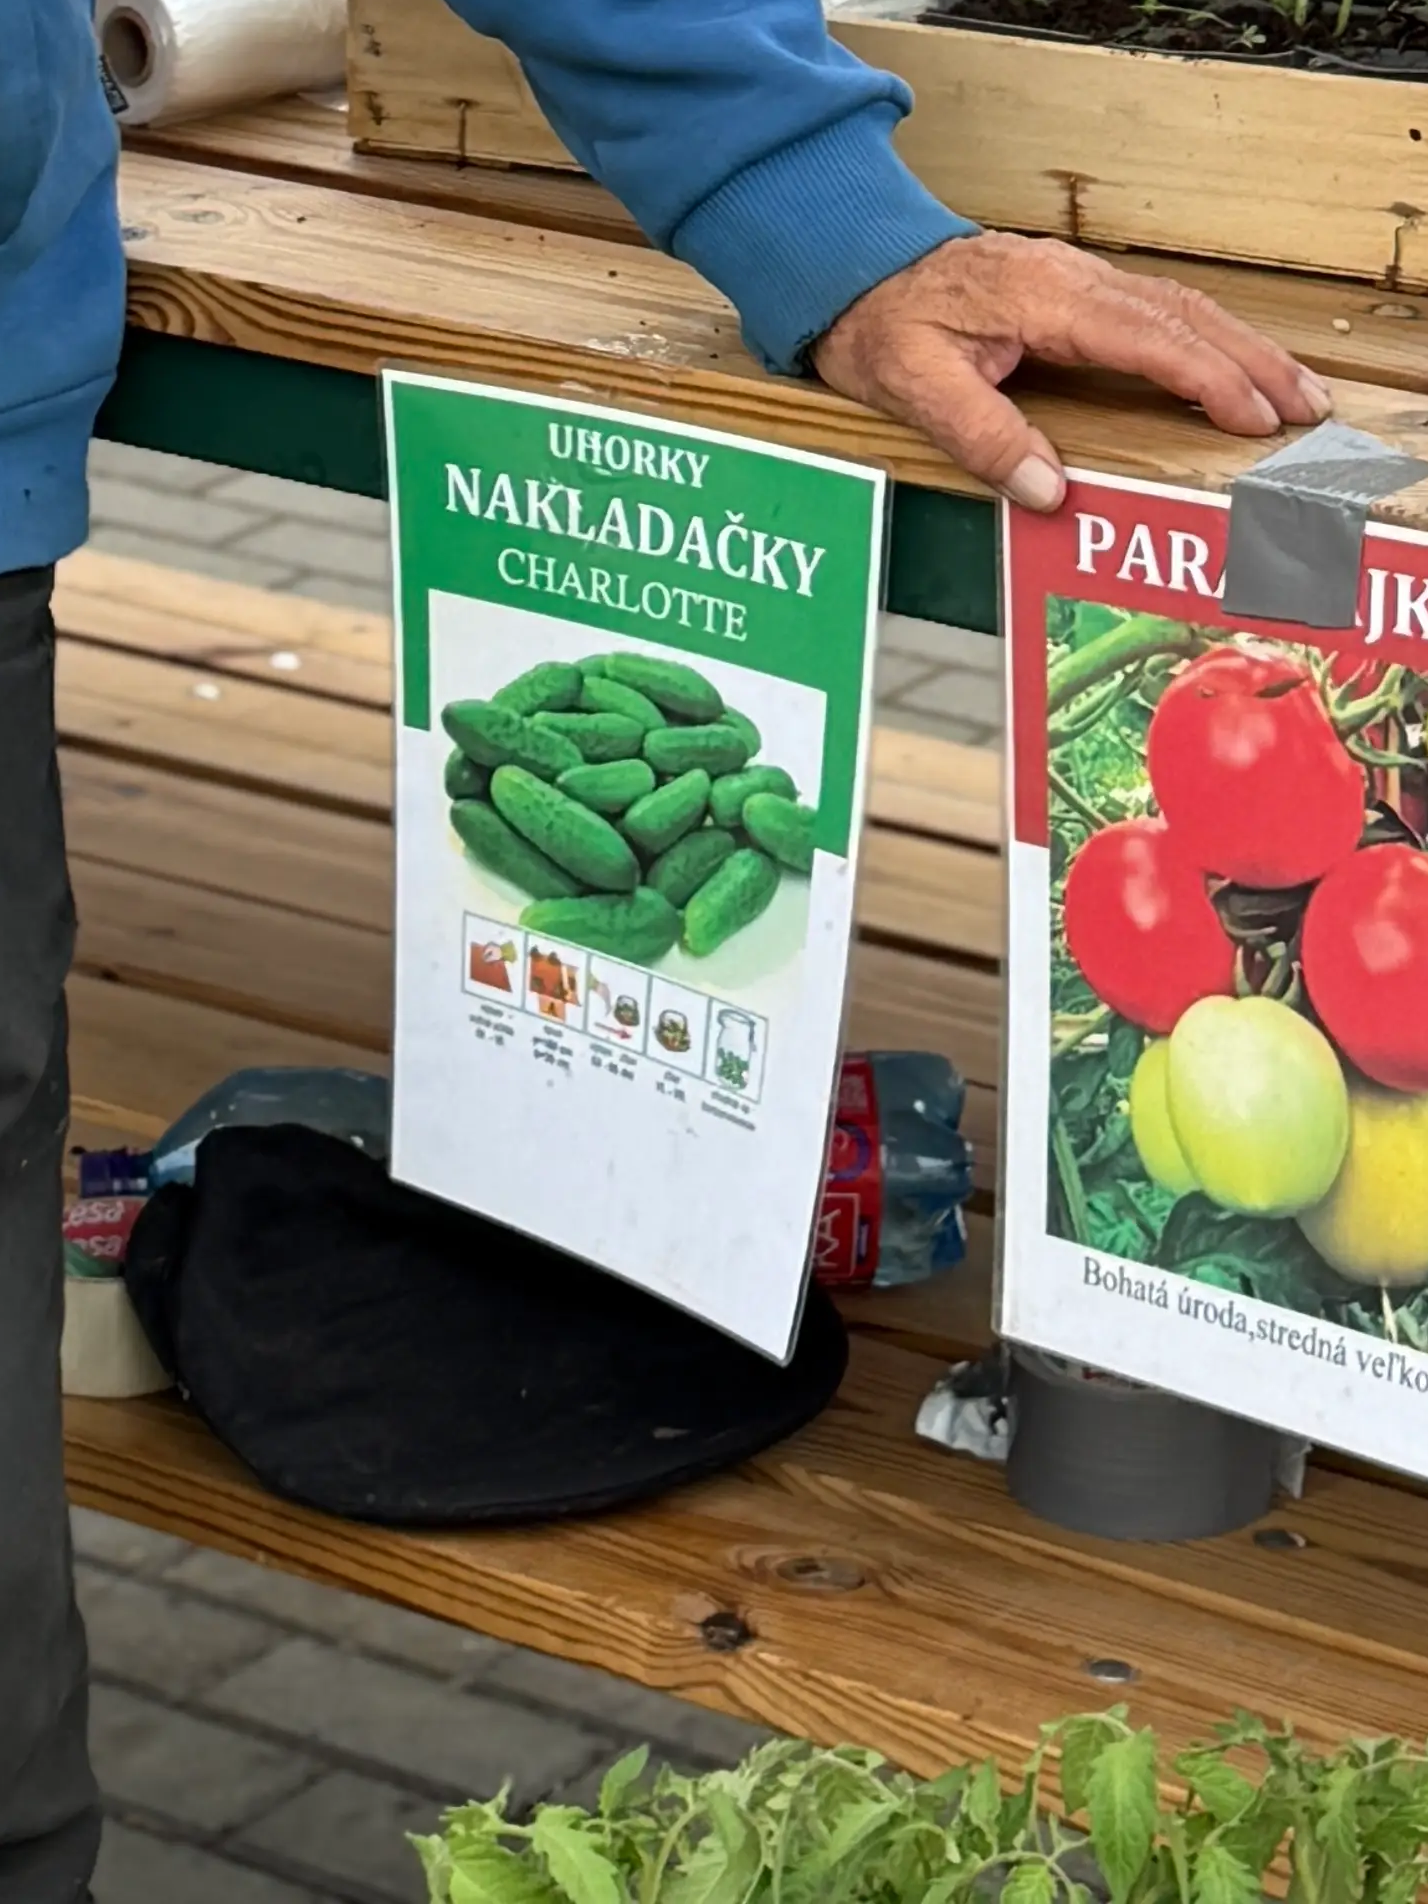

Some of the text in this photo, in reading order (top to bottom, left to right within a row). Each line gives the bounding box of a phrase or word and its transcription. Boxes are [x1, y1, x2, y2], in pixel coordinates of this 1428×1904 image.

[548, 422, 710, 489] UHORKY
[444, 463, 826, 597] NAKLADAČKY
[497, 548, 748, 642] CHARLOTTE
[62, 1201, 125, 1231] esa
[1082, 1255, 1170, 1311] Bohatá
